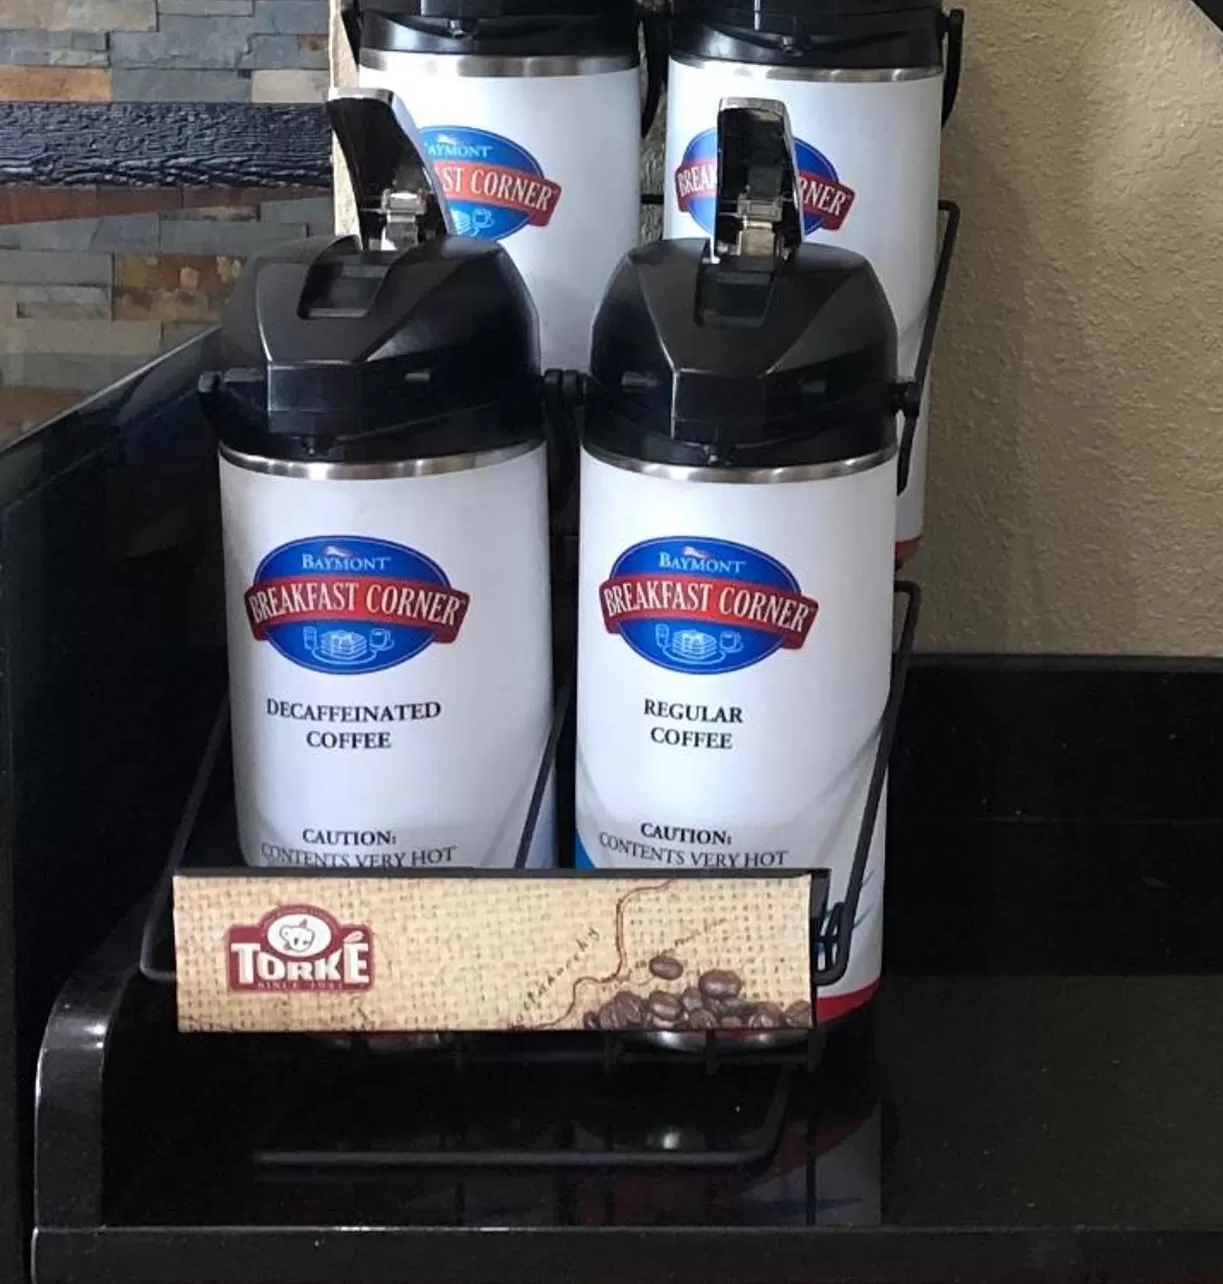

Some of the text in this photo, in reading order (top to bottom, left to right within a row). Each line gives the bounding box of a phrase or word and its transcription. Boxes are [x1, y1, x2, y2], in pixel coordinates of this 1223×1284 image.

[424, 143, 488, 158] AYMONT
[470, 169, 552, 212] CORNER
[800, 176, 847, 216] RNER
[302, 552, 387, 572] BAYMONT
[659, 551, 744, 574] BAYMONT
[249, 581, 461, 626] BREAKFAST CORNER
[603, 579, 811, 633] BREAKFAST CORNER
[266, 697, 442, 723] DECAFFEINATED
[643, 697, 743, 724] REGULAR
[306, 730, 392, 749] COFFEE
[650, 726, 733, 750] COFFEE
[302, 827, 397, 846] CAUTION:
[640, 822, 732, 845] CAUTION:
[261, 842, 457, 868] CONTENTS VERY HOT
[599, 831, 789, 867] CONTENTS VERY HOT
[231, 930, 370, 984] TORKÉ
